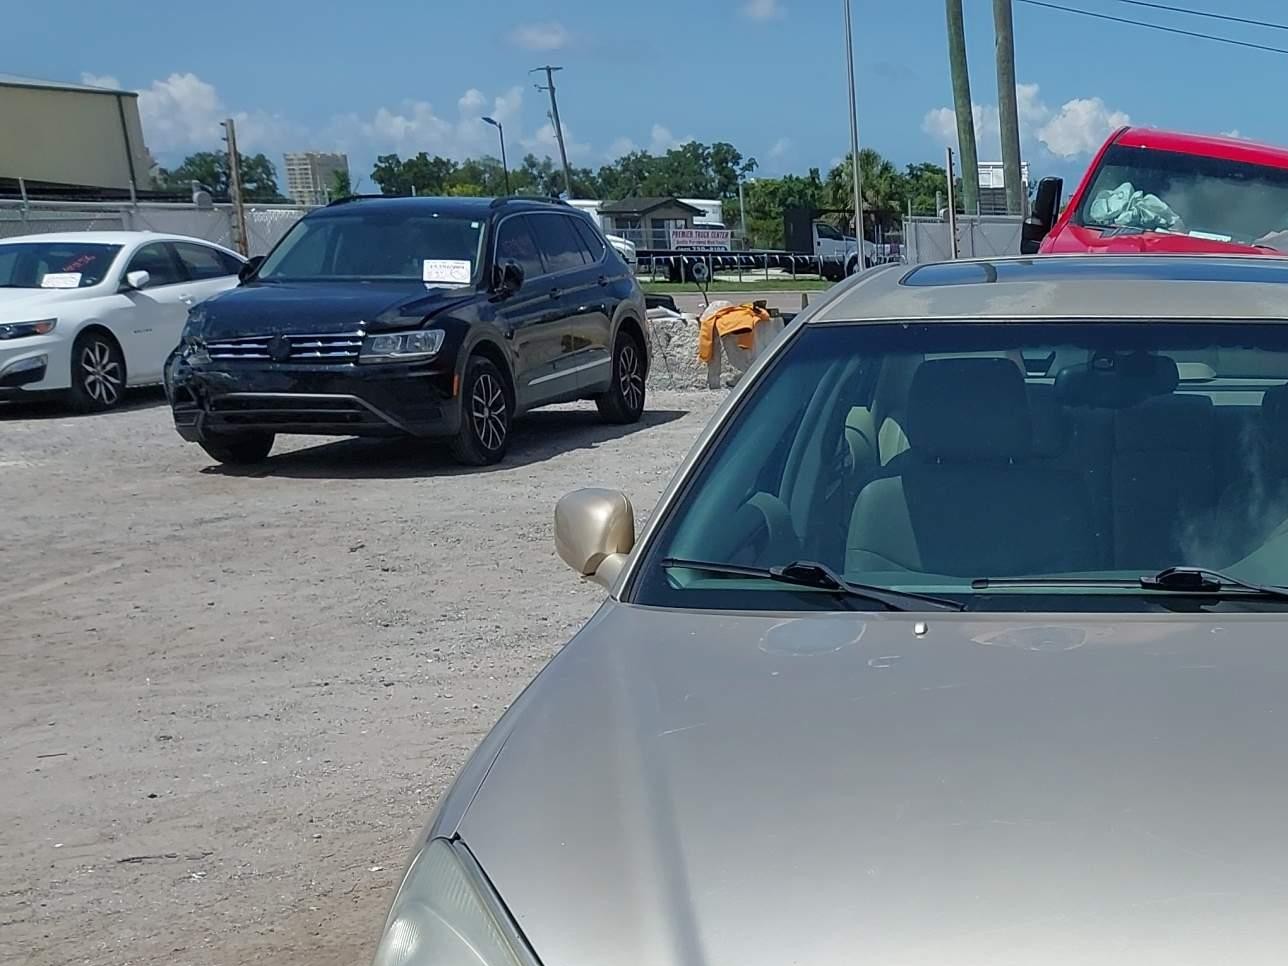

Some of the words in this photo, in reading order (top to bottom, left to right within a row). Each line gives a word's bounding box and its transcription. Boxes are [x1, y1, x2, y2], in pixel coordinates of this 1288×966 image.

[672, 230, 693, 239] PREMIER
[695, 231, 710, 239] TRUCK
[711, 231, 729, 239] CENTER
